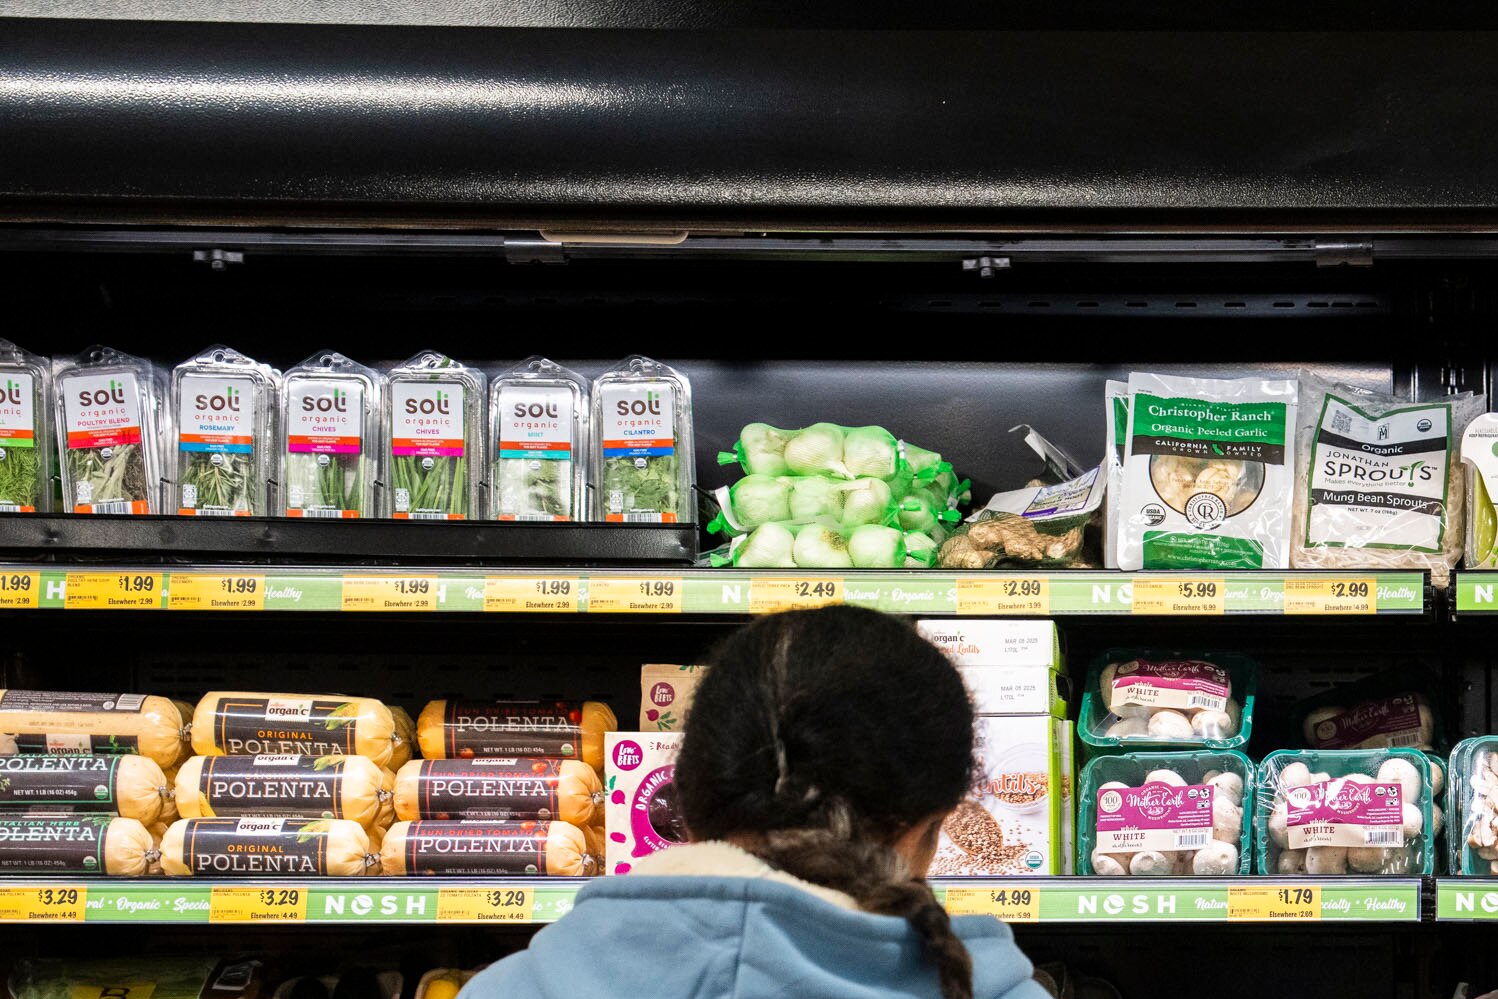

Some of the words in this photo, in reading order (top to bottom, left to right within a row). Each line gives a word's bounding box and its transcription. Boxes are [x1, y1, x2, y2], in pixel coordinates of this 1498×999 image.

[79, 380, 125, 407] soli
[195, 386, 240, 412] soli
[617, 391, 660, 416] soli
[80, 407, 127, 420] organic
[194, 413, 240, 424] organic
[1148, 405, 1227, 422] Christopher
[1232, 410, 1272, 421] Ranch
[77, 419, 107, 428] POULTRY
[109, 417, 130, 426] BLEND
[1152, 423, 1194, 434] Organic
[1197, 427, 1231, 437] Peeled
[1235, 428, 1268, 437] Garlic
[1155, 440, 1208, 451] CALIFORNIA
[1227, 445, 1261, 453] FAMILY
[1173, 447, 1208, 455] GROWN
[1361, 444, 1404, 455] Organic
[1326, 451, 1389, 467] JONATHAN
[1323, 492, 1354, 504] Mung
[1357, 494, 1384, 503] Bean
[1387, 496, 1428, 509] Sprouts
[118, 575, 154, 592] $1.99
[221, 578, 257, 594] $1.99
[639, 581, 674, 597] $1.99
[795, 582, 836, 598] $2.49
[1003, 580, 1041, 596] $2.99
[1178, 582, 1217, 598] $5.99
[1331, 582, 1368, 598] $2.99
[263, 584, 303, 602] Healthy
[108, 597, 137, 606] Elsewhere
[1173, 603, 1201, 611] Elsewhere
[1127, 687, 1159, 697] WHITE
[457, 716, 571, 732] POLENTA
[257, 731, 313, 740] ORIGINAL
[617, 754, 640, 767] BEETS
[213, 782, 330, 798] POLENTA
[431, 780, 548, 797] POLENTA
[1126, 793, 1160, 808] Mother
[1161, 791, 1185, 806] Earth
[484, 829, 534, 837] TOMATO
[1113, 832, 1146, 841] WHITE
[1303, 827, 1335, 835] WHITE
[227, 844, 284, 853] ORIGINAL
[418, 837, 536, 853] POLENTA
[197, 855, 316, 872] POLENTA
[38, 889, 77, 905] $3.29
[486, 890, 525, 907] $3.29
[991, 890, 1030, 906] $4.99
[1278, 889, 1312, 904] $1.79
[324, 895, 426, 915] NOSH
[477, 912, 506, 920] Elsewhere
